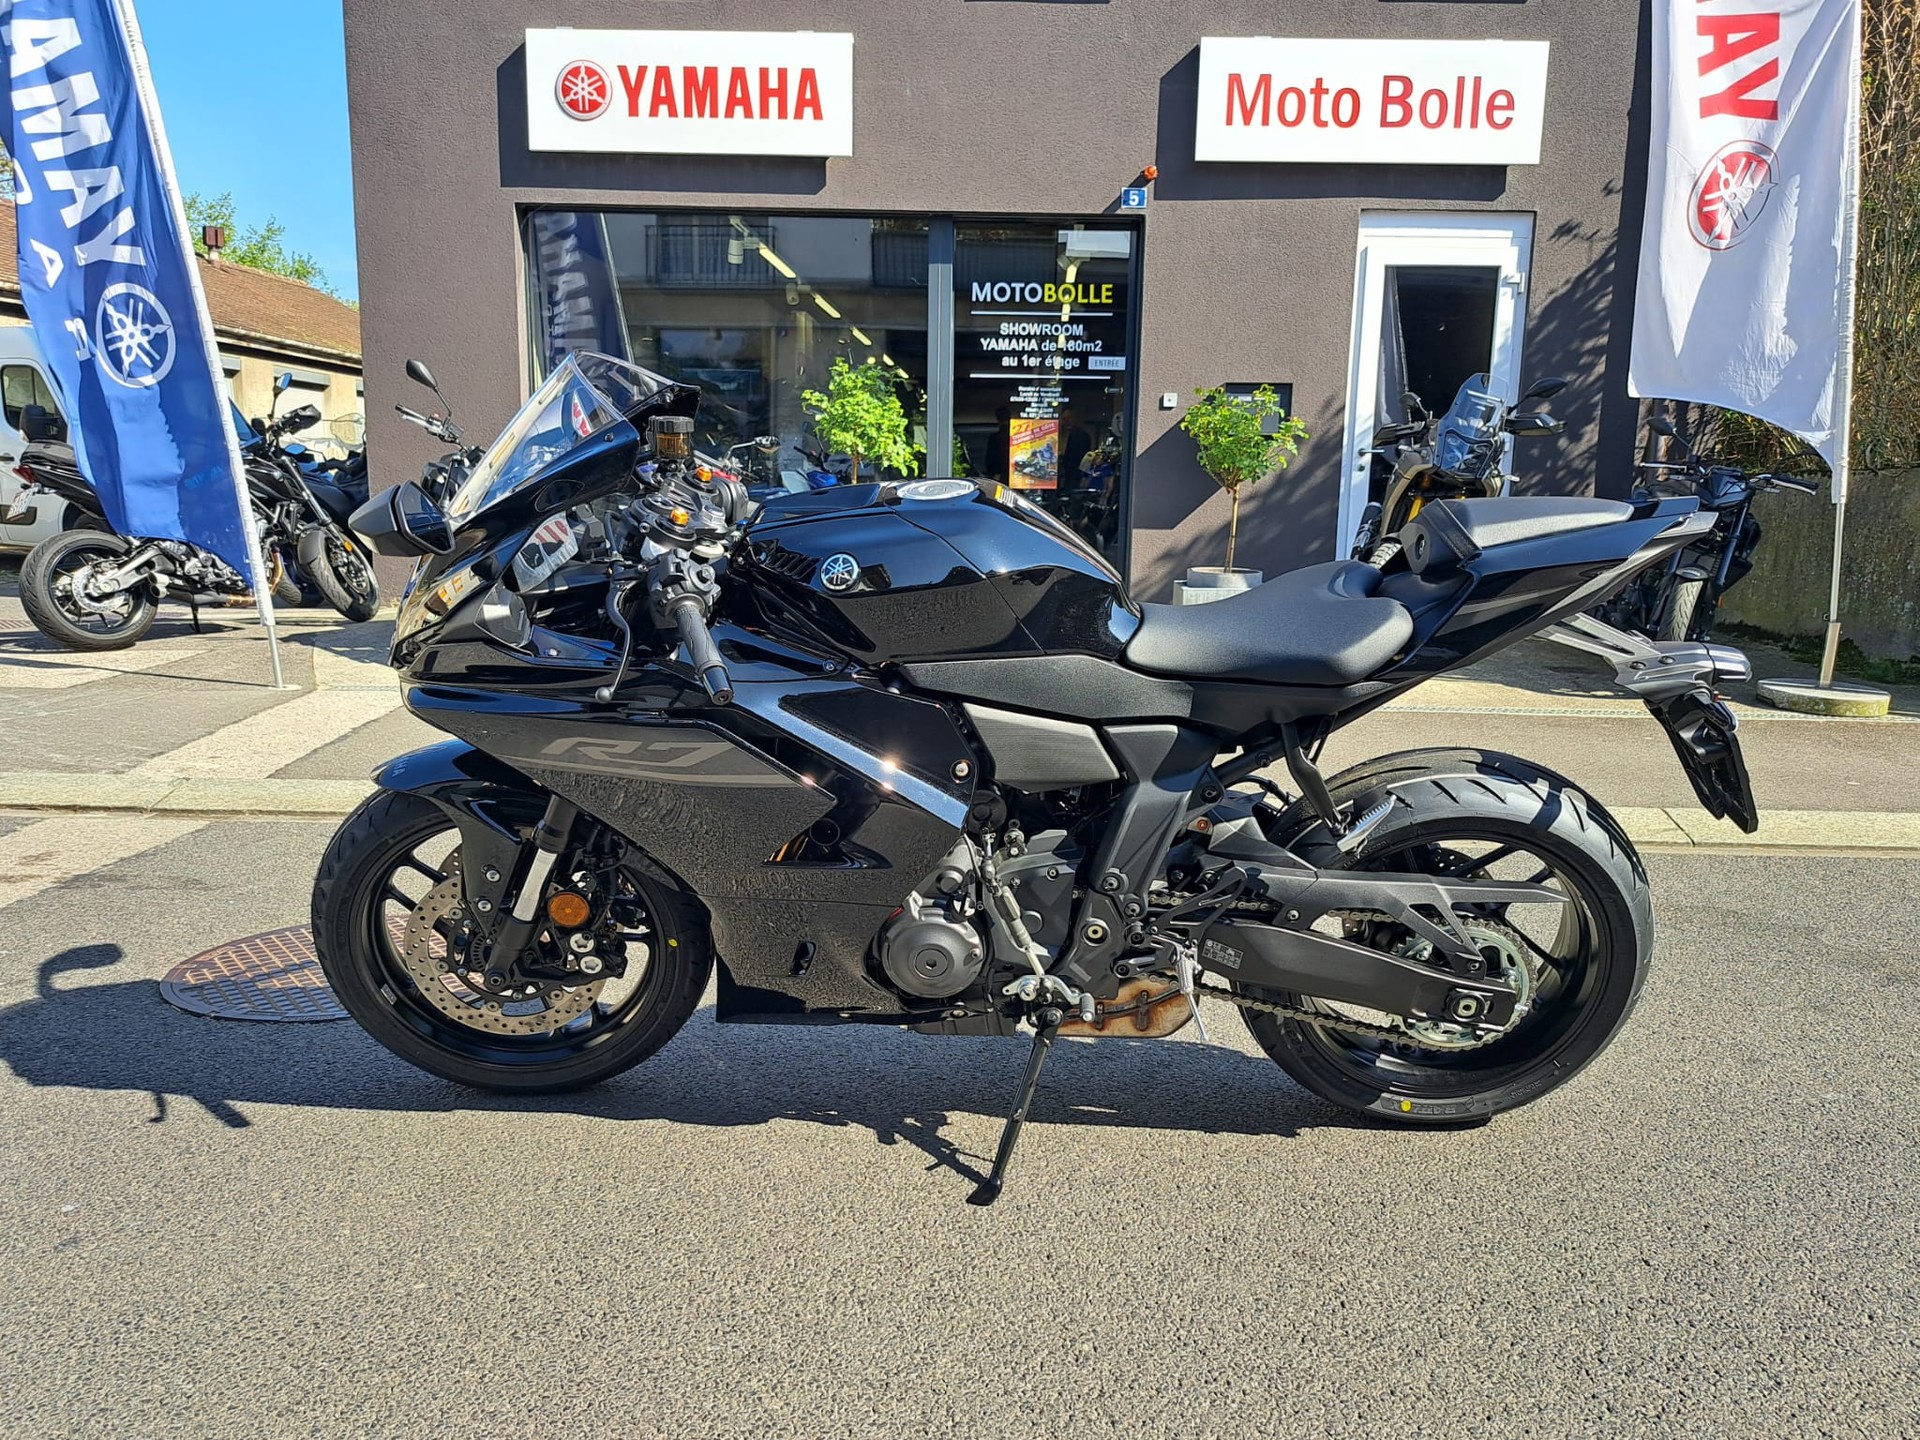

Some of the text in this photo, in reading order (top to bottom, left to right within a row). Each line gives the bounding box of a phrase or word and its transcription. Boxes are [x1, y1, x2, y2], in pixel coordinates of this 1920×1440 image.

[617, 65, 823, 121] YAMAHA
[1224, 73, 1515, 130] Moto Bolle
[1128, 190, 1140, 206] 5
[971, 282, 1113, 304] MOTOBOLLE
[1000, 322, 1084, 336] SHOWROOM
[980, 338, 1038, 351] YAMAHA
[1041, 339, 1057, 351] de
[1002, 357, 1018, 367] au
[1021, 355, 1042, 367] 1er
[541, 737, 736, 768] R7
